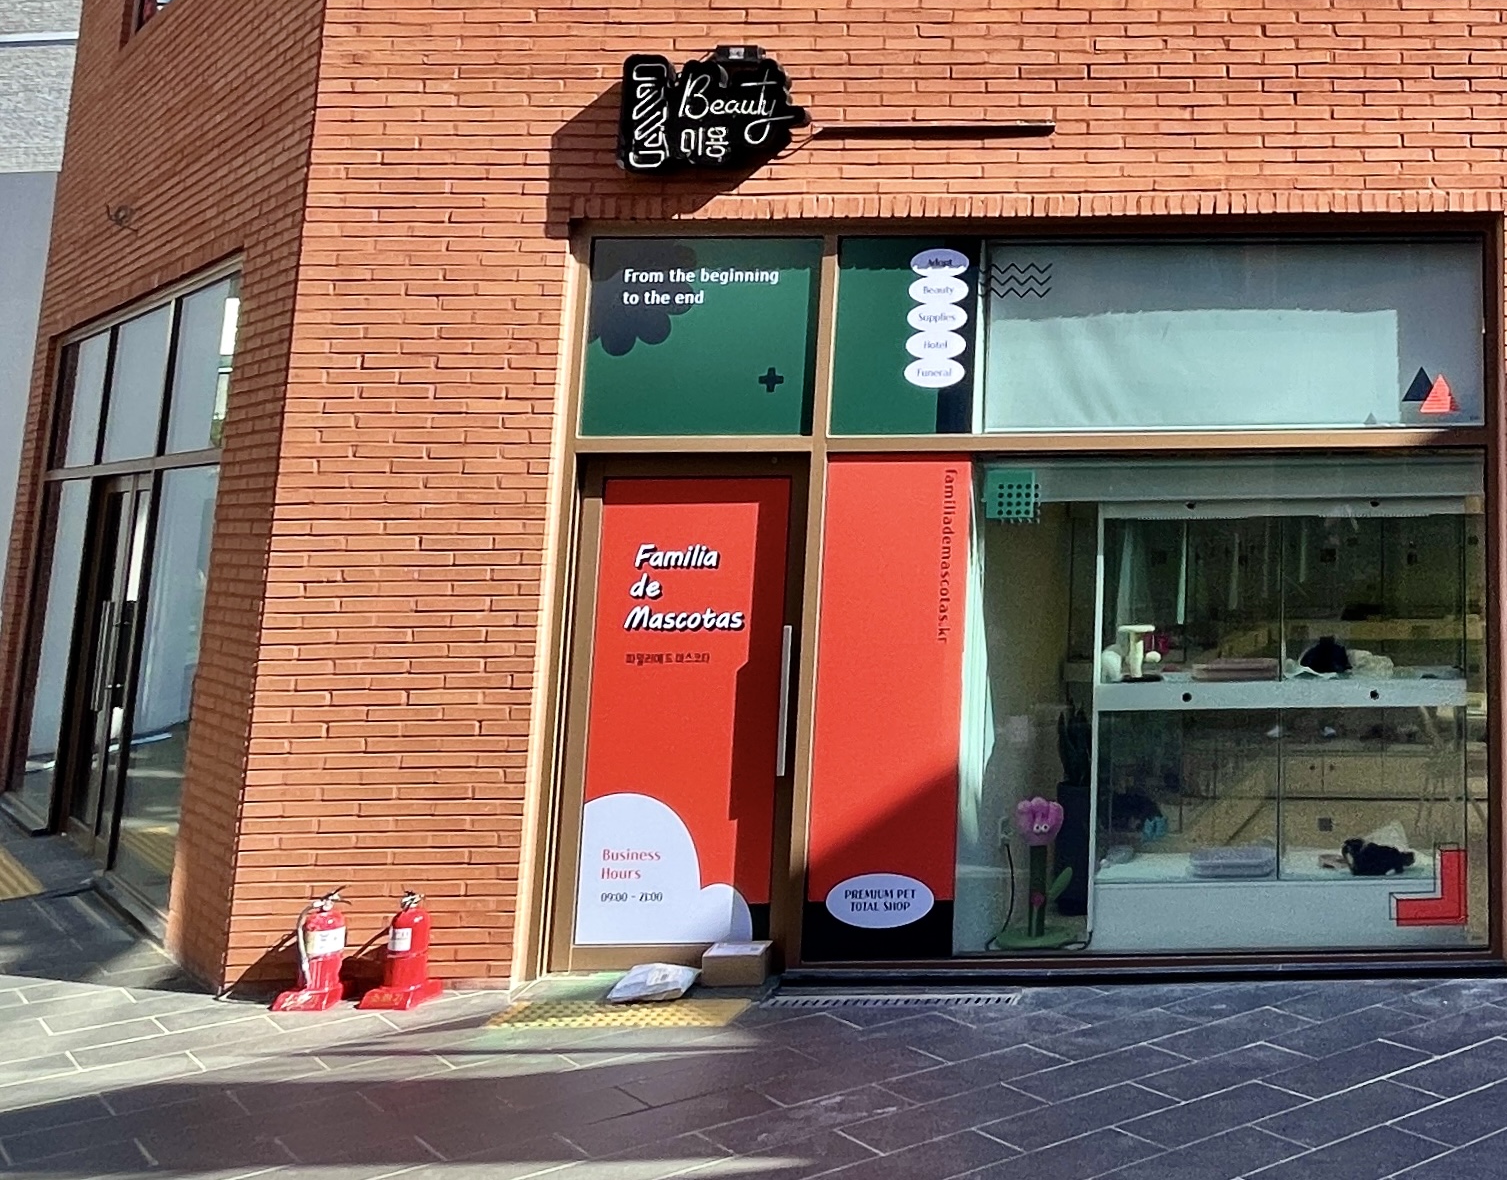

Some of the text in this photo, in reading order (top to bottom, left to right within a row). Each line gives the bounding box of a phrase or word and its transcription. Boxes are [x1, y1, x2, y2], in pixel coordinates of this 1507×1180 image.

[678, 69, 795, 145] Beauty
[680, 126, 730, 158] 미용
[623, 267, 779, 285] From the beginning
[923, 286, 954, 295] Beauty
[622, 290, 705, 305] to the end
[918, 313, 956, 323] Supplies
[924, 340, 948, 349] Hotel
[917, 368, 952, 377] Funeral
[634, 543, 720, 569] Familia
[629, 572, 662, 600] de
[623, 605, 745, 632] Mascotas
[602, 848, 661, 862] Business
[601, 867, 642, 880] Hours
[600, 892, 628, 902] 09:00
[844, 889, 916, 900] PREMIUM PET
[850, 901, 911, 912] TOTAL SHOP
